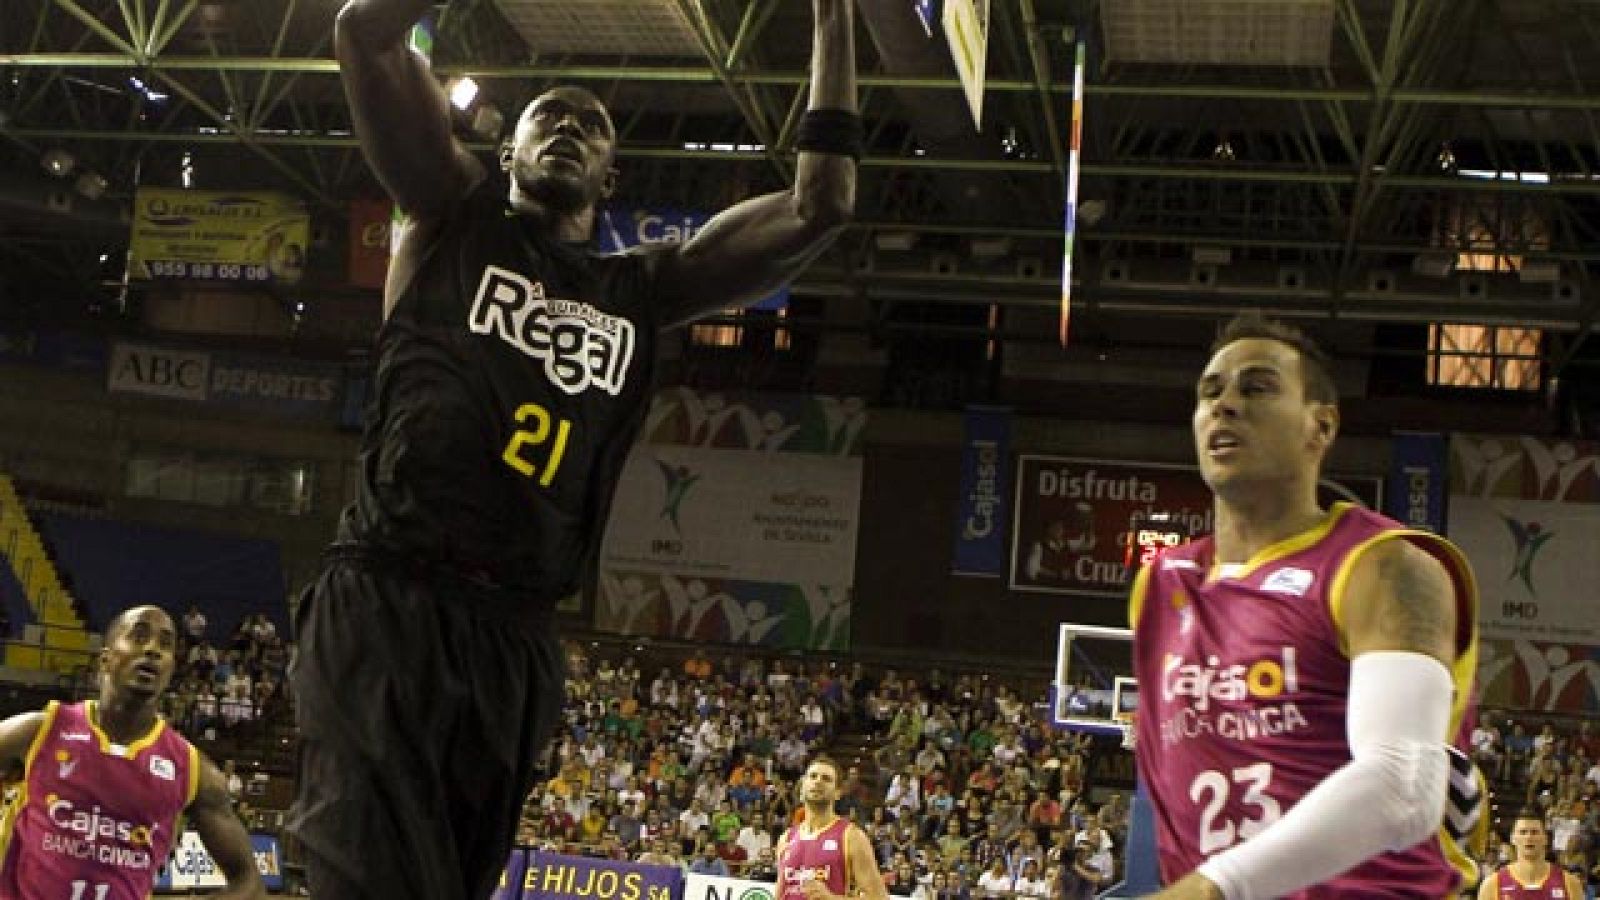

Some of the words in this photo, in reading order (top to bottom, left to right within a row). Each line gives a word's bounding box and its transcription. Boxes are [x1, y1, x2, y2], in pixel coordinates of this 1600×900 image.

[470, 265, 635, 396] Regal
[117, 351, 201, 389] ABC
[212, 369, 334, 401] DEPORTES
[502, 404, 571, 488] 21
[1039, 468, 1158, 502] Disfruta
[965, 439, 1001, 538] Cajasol
[1189, 761, 1283, 854] 23
[543, 863, 643, 900] HIJOS
